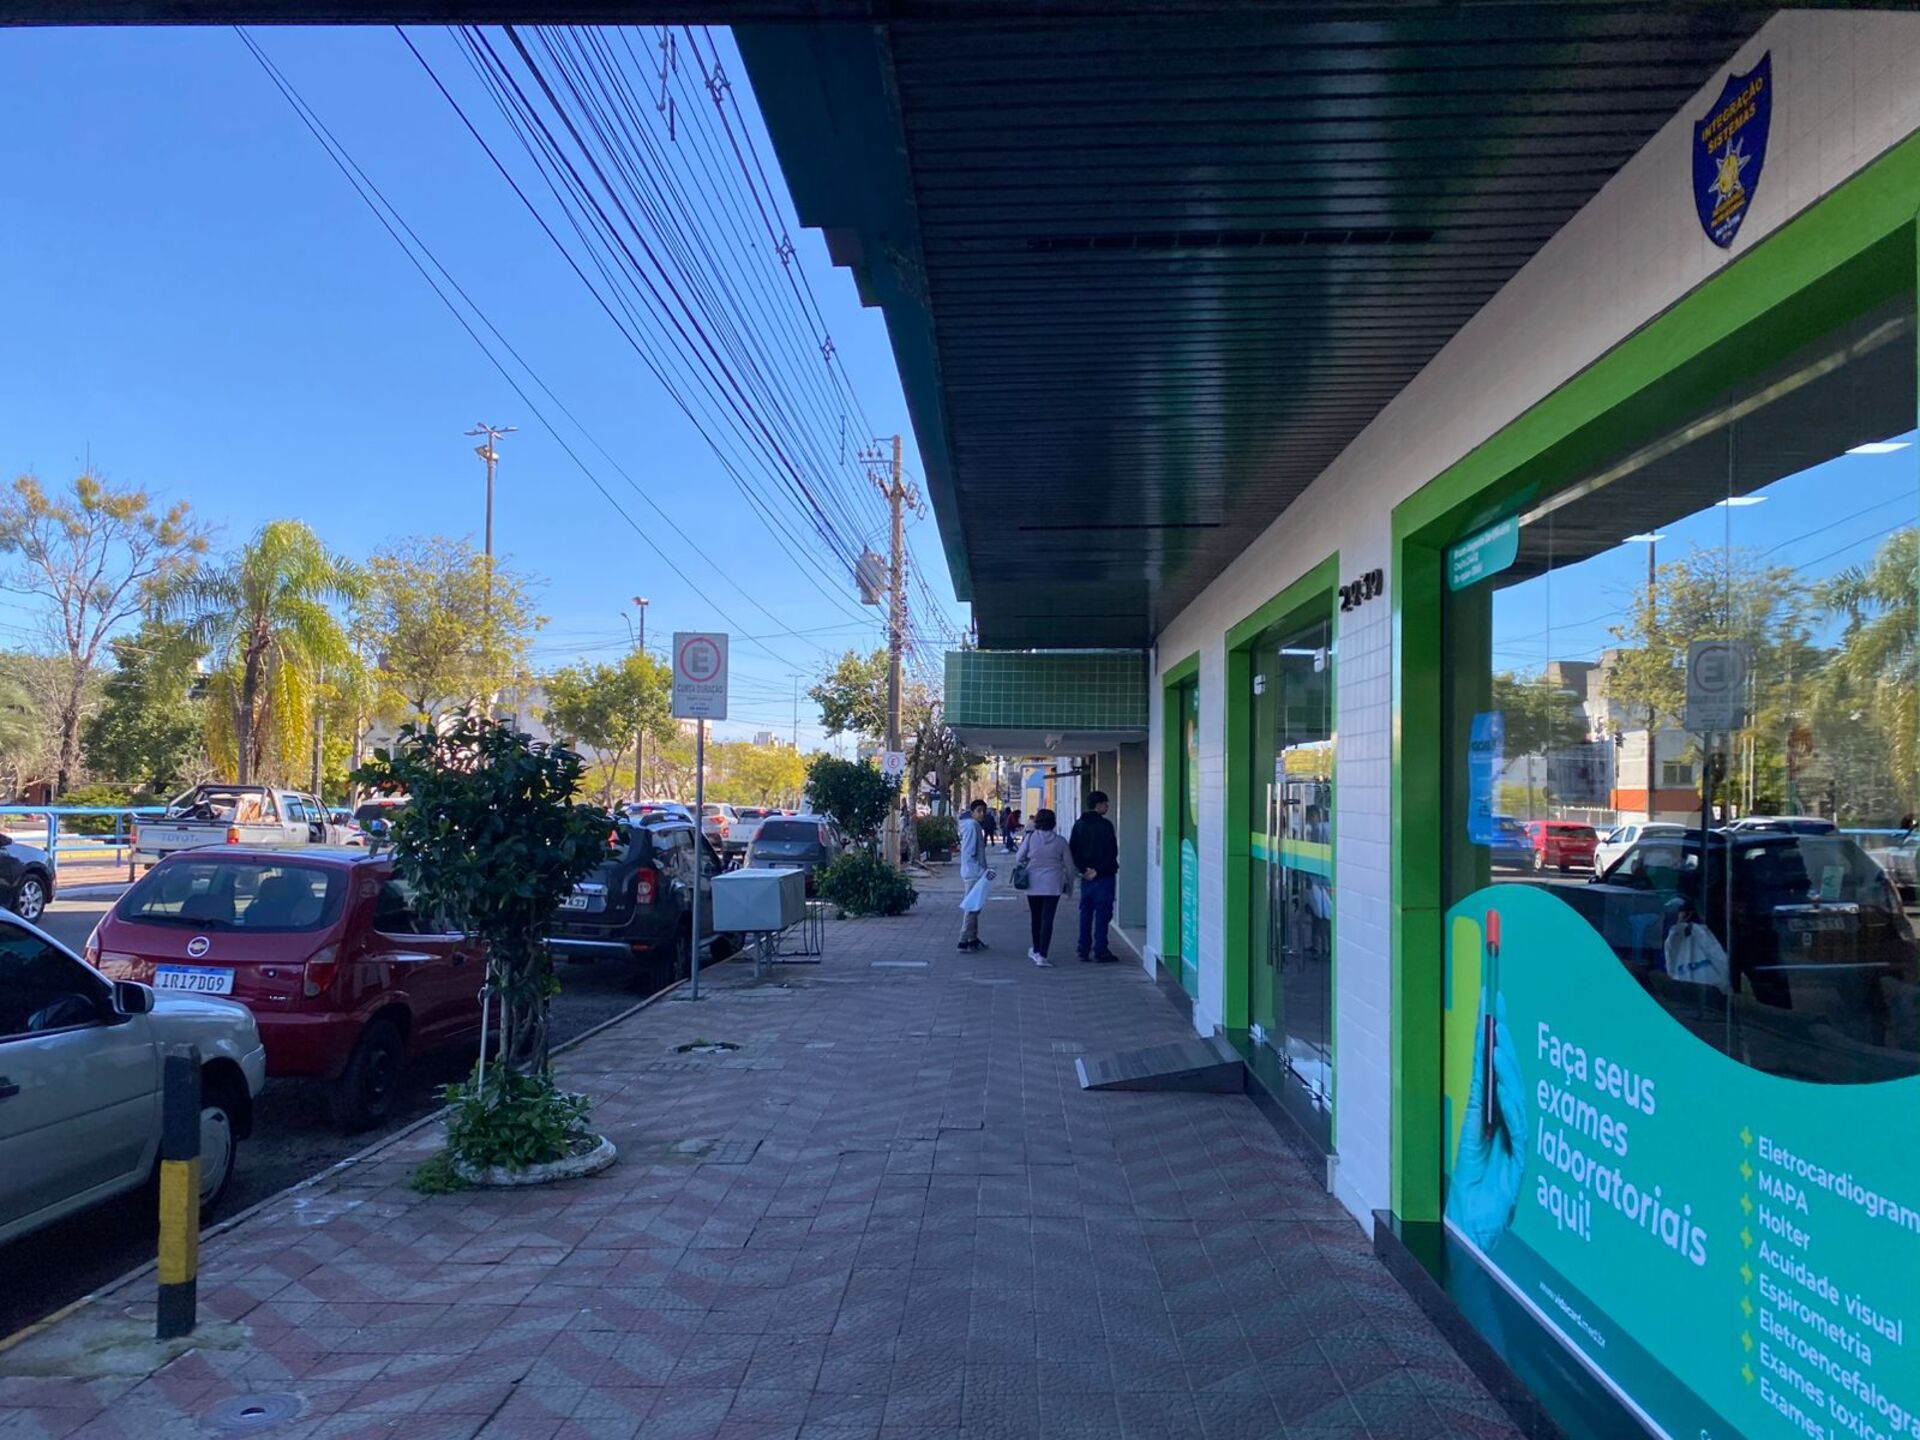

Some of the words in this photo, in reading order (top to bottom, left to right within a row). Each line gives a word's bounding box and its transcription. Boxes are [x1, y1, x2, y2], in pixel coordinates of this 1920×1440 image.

[692, 648, 709, 672] E
[1537, 1021, 1587, 1085] Faça
[1594, 1056, 1656, 1116] seus
[1537, 1078, 1629, 1157] exames
[1537, 1117, 1708, 1267] laboratoriais
[1537, 1174, 1592, 1242] aqui!
[1758, 1170, 1809, 1216] MAPA
[1758, 1205, 1811, 1251] Holter
[1758, 1239, 1839, 1306] Acuidade
[1844, 1293, 1903, 1346] visual
[1759, 1273, 1872, 1366] Espirometria
[1759, 1341, 1825, 1408] Exames
[1760, 1376, 1825, 1440] Exames
